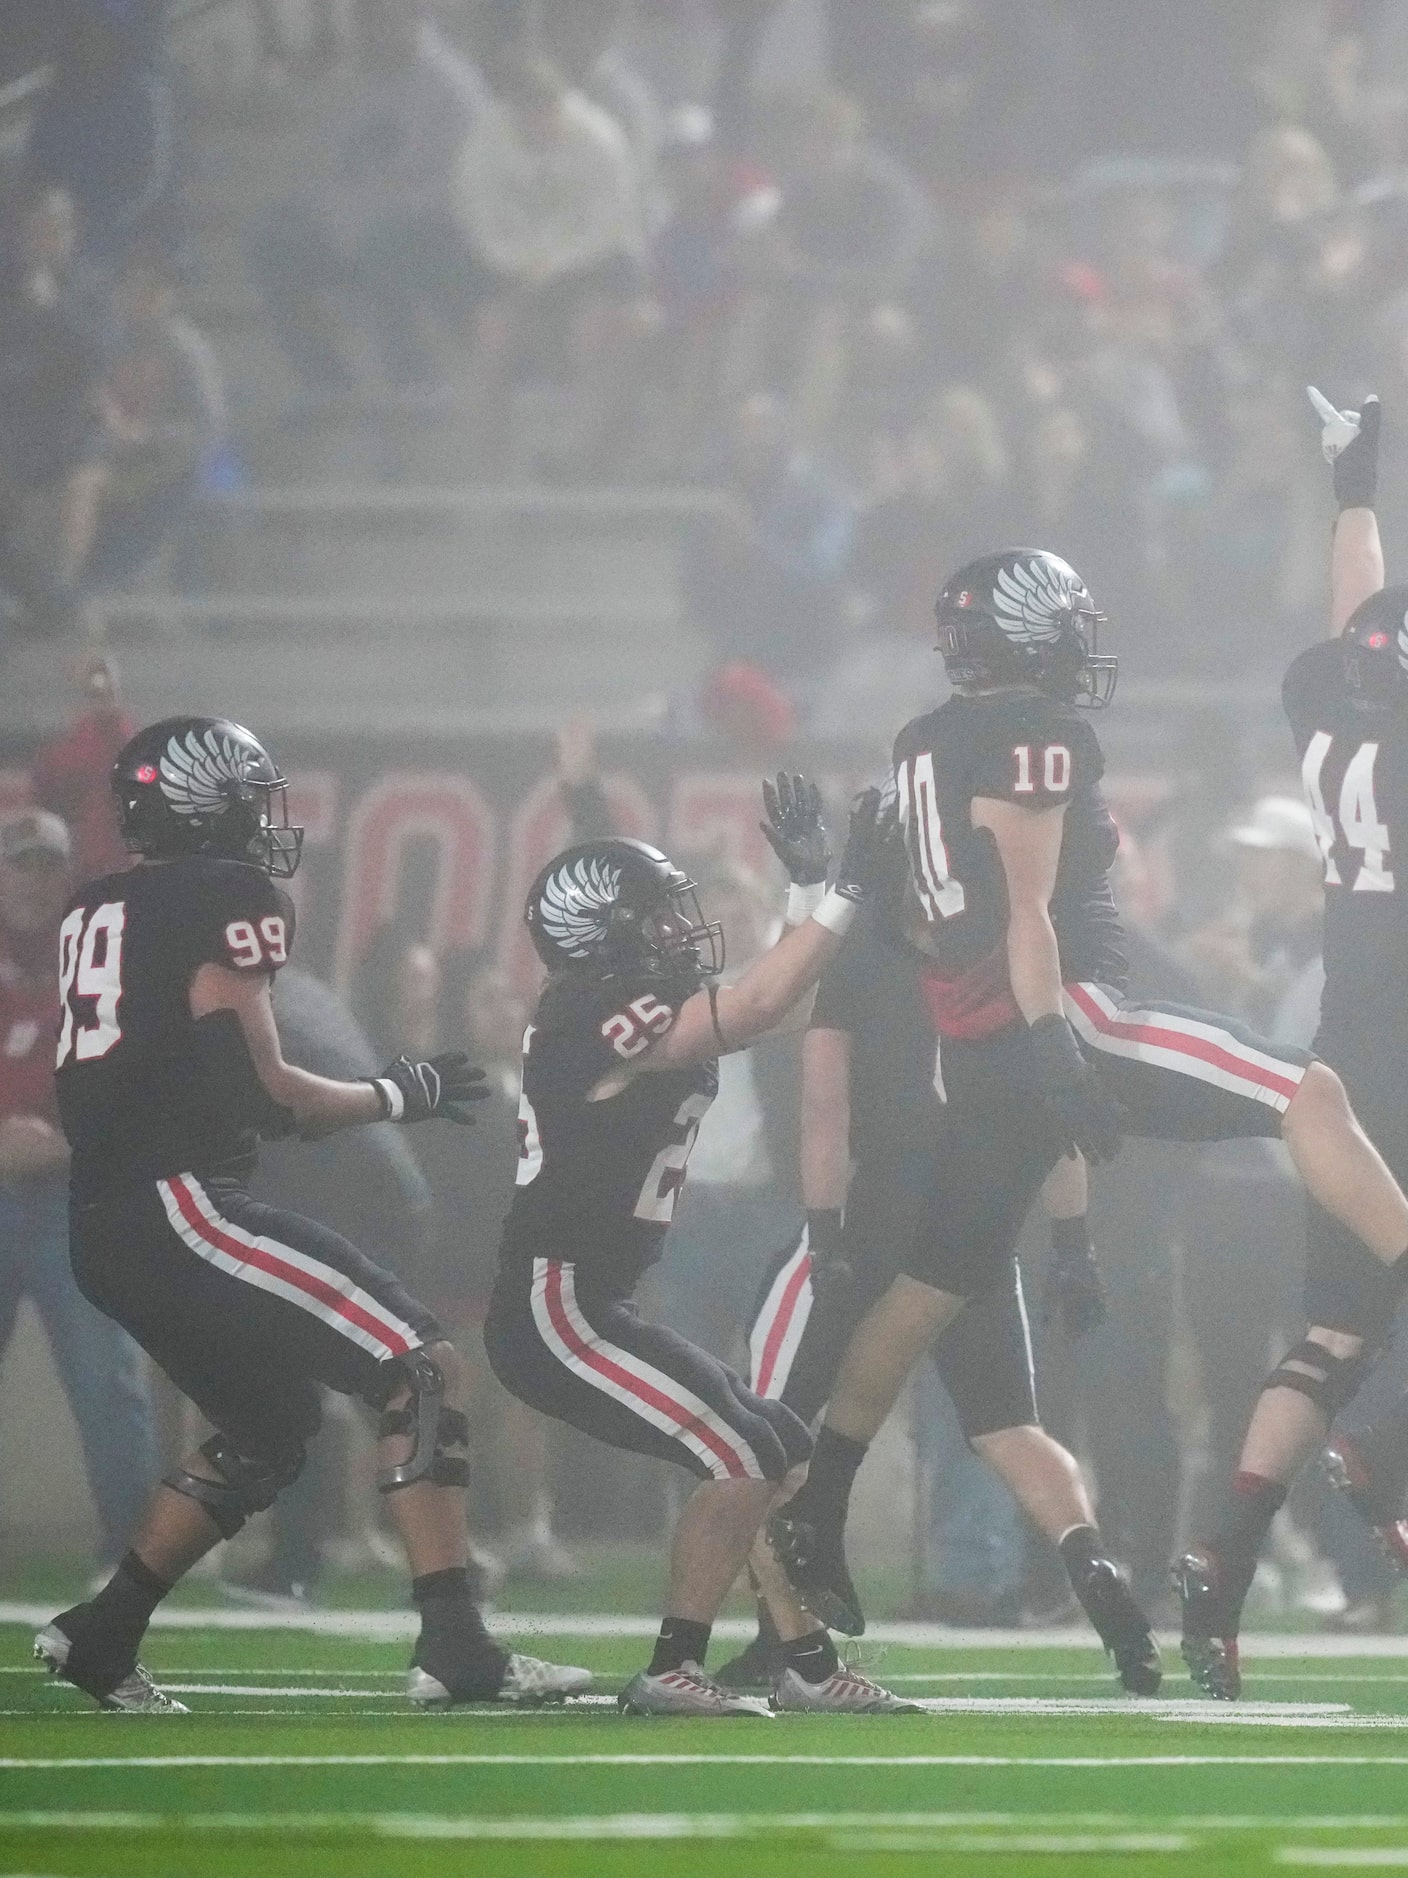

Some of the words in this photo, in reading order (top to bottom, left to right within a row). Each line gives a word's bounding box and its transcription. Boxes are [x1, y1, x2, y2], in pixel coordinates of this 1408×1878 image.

[959, 591, 969, 607] S
[1013, 744, 1071, 792] 10
[1302, 730, 1396, 893] 44
[225, 915, 288, 968] 99
[55, 901, 126, 1070] 99
[601, 993, 673, 1049] 25
